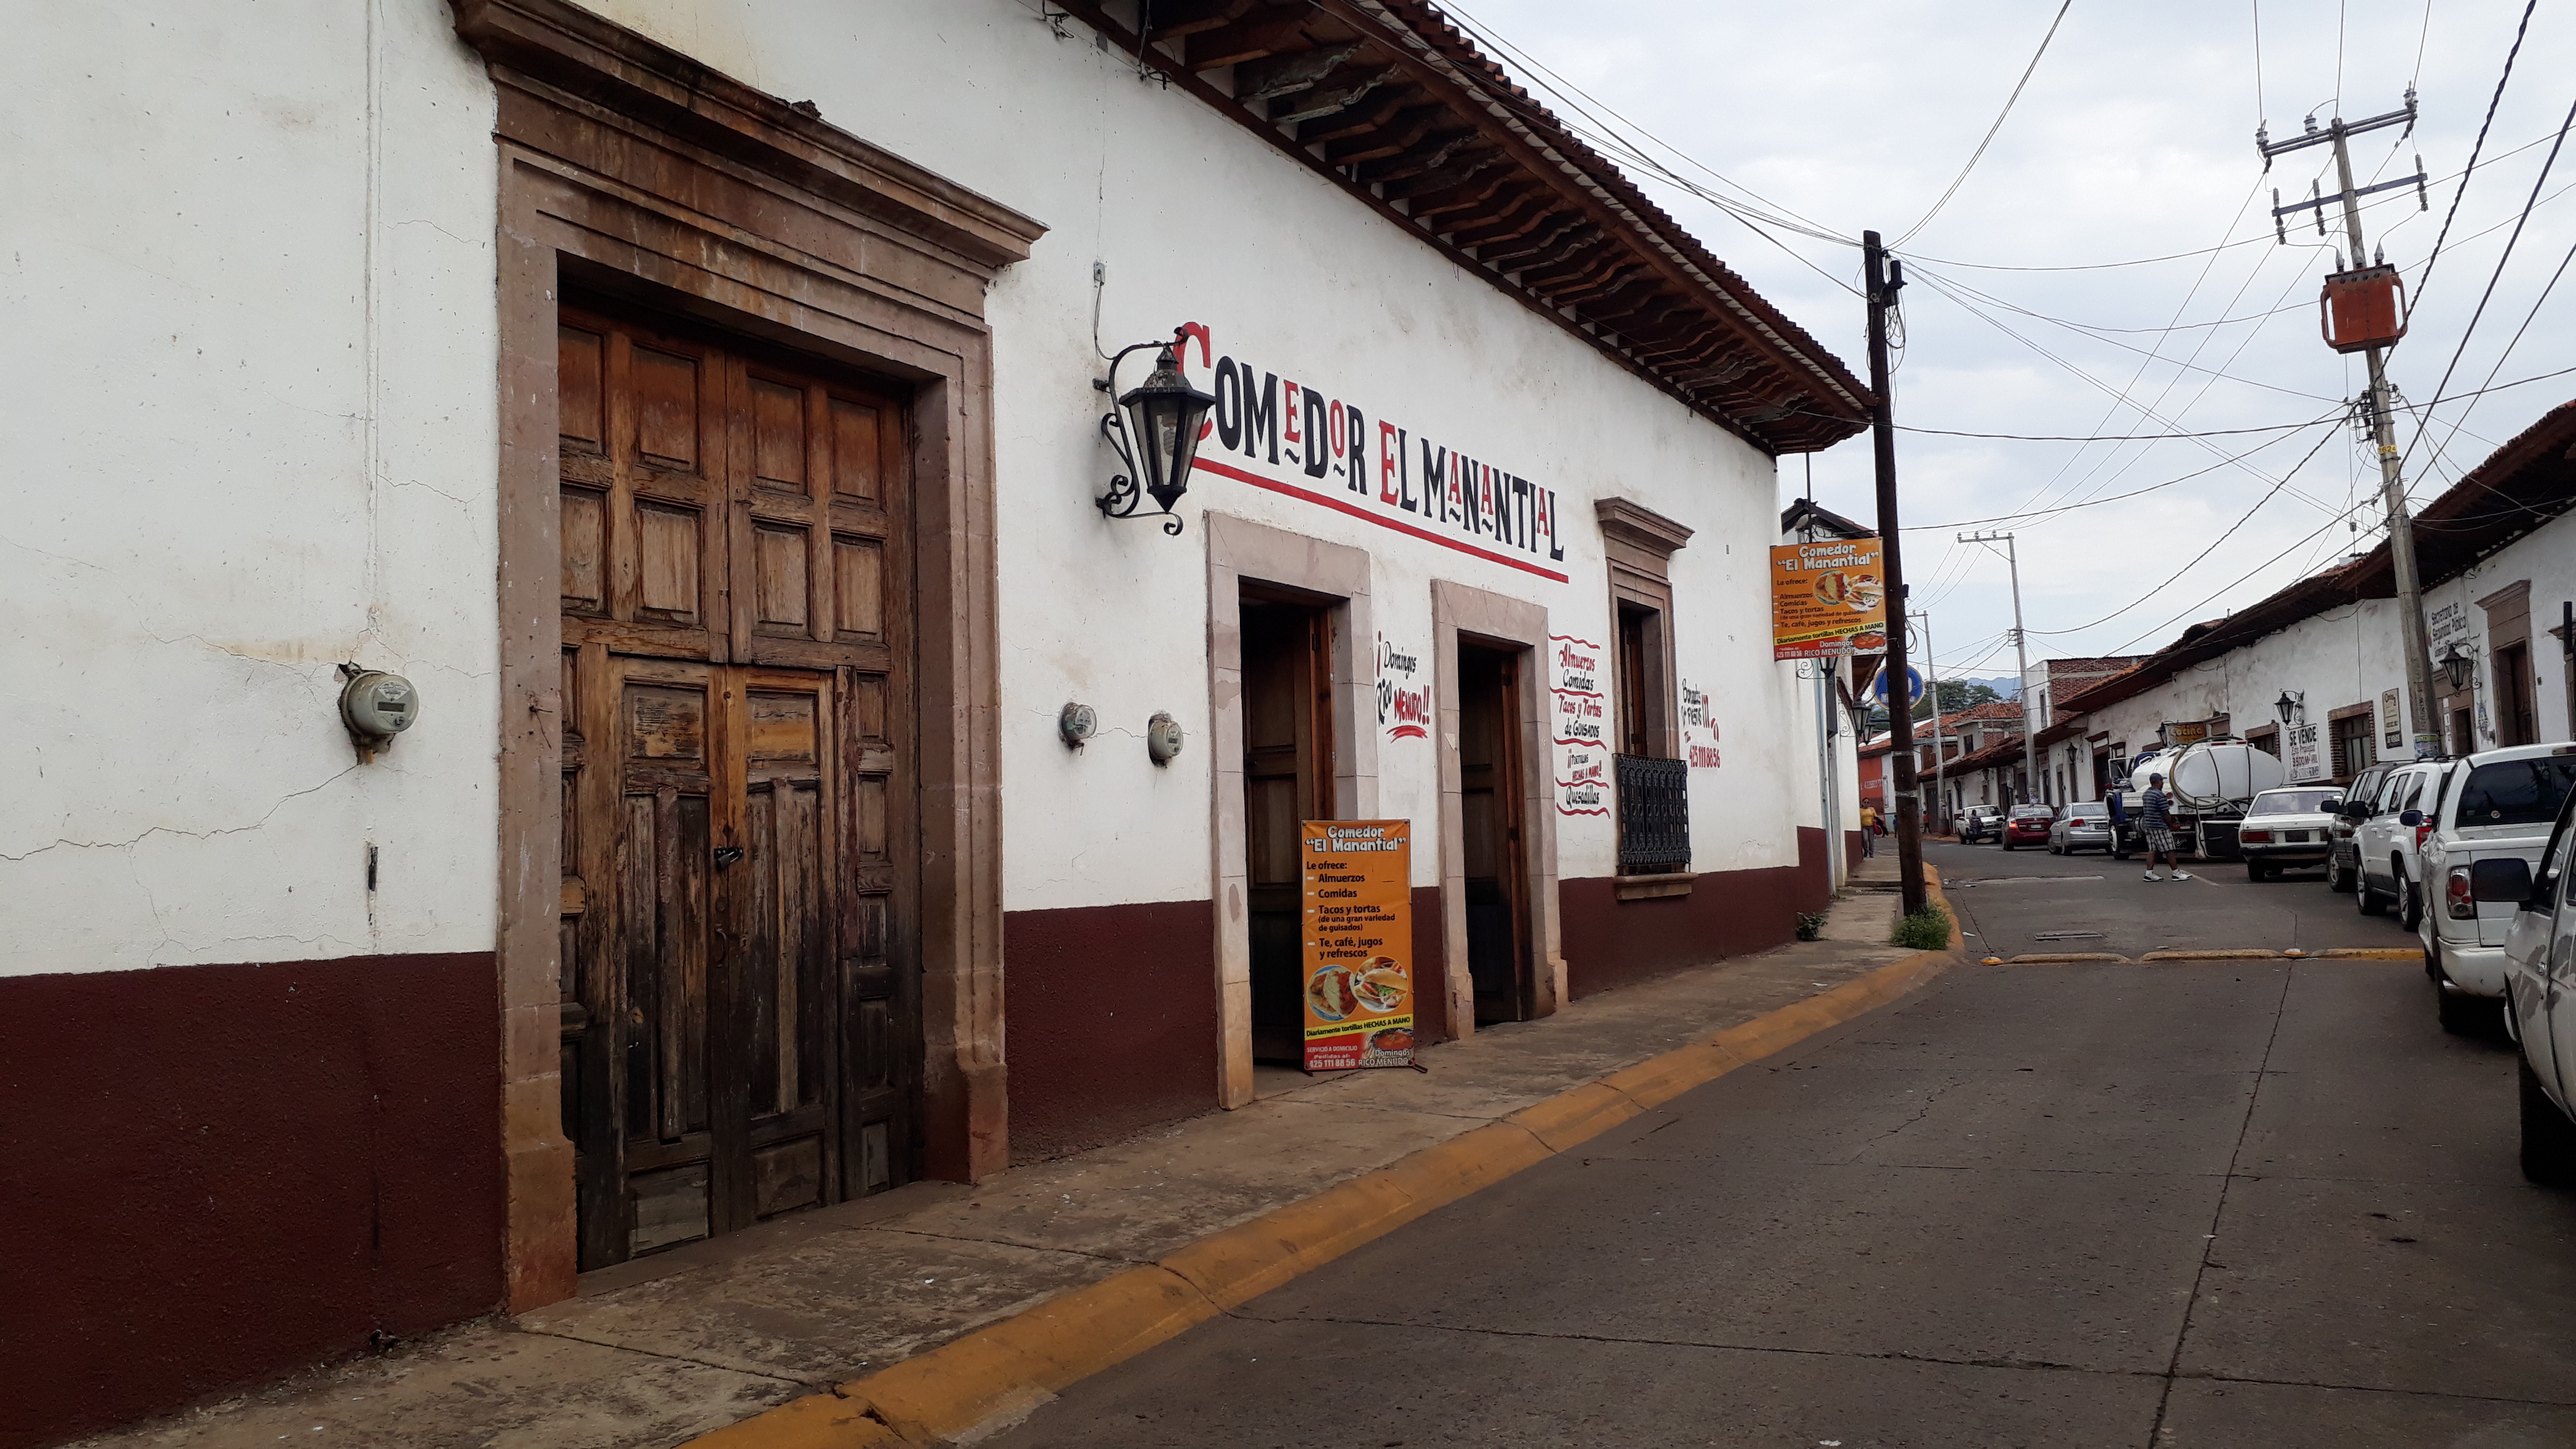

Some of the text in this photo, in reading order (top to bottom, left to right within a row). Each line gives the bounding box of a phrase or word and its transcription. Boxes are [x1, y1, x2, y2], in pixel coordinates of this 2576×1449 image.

[1378, 419, 1417, 512] EL
[1421, 437, 1564, 562] MANANTIAL
[1799, 543, 1856, 557] Comedor
[1807, 620, 1826, 628] jugos
[1813, 630, 1833, 638] tortillas
[1835, 627, 1858, 635] HECHAS
[1819, 640, 1853, 649] Domingos
[1559, 643, 1595, 671] Almuerzos
[1563, 669, 1594, 691] Comidas
[1375, 678, 1392, 728] Rico
[1558, 694, 1602, 718] Tacos y Tortas
[1564, 717, 1600, 738] de GUISADOS
[2290, 726, 2317, 746] SE VENDE
[1566, 784, 1599, 809] Quesadillas
[1327, 825, 1385, 838] Comedor
[1307, 861, 1347, 870] Le ofrece:
[1318, 874, 1365, 883] Almuerzos
[1318, 889, 1357, 898] Comidas
[1319, 905, 1381, 915] Tacos y tortas
[1319, 915, 1330, 924] (de
[1365, 913, 1395, 921] variedad
[1329, 924, 1363, 933] guisados)
[1319, 937, 1383, 948] Te, café, jugos
[1319, 948, 1368, 960] y refrescos
[1306, 1026, 1341, 1037] Diariamente
[1342, 1023, 1363, 1032] tortillas
[1364, 1019, 1387, 1029] HECHAS
[1392, 1017, 1410, 1025] MANO
[1375, 1049, 1410, 1058] Domingos
[1309, 1058, 1355, 1068] 425 111 88 56
